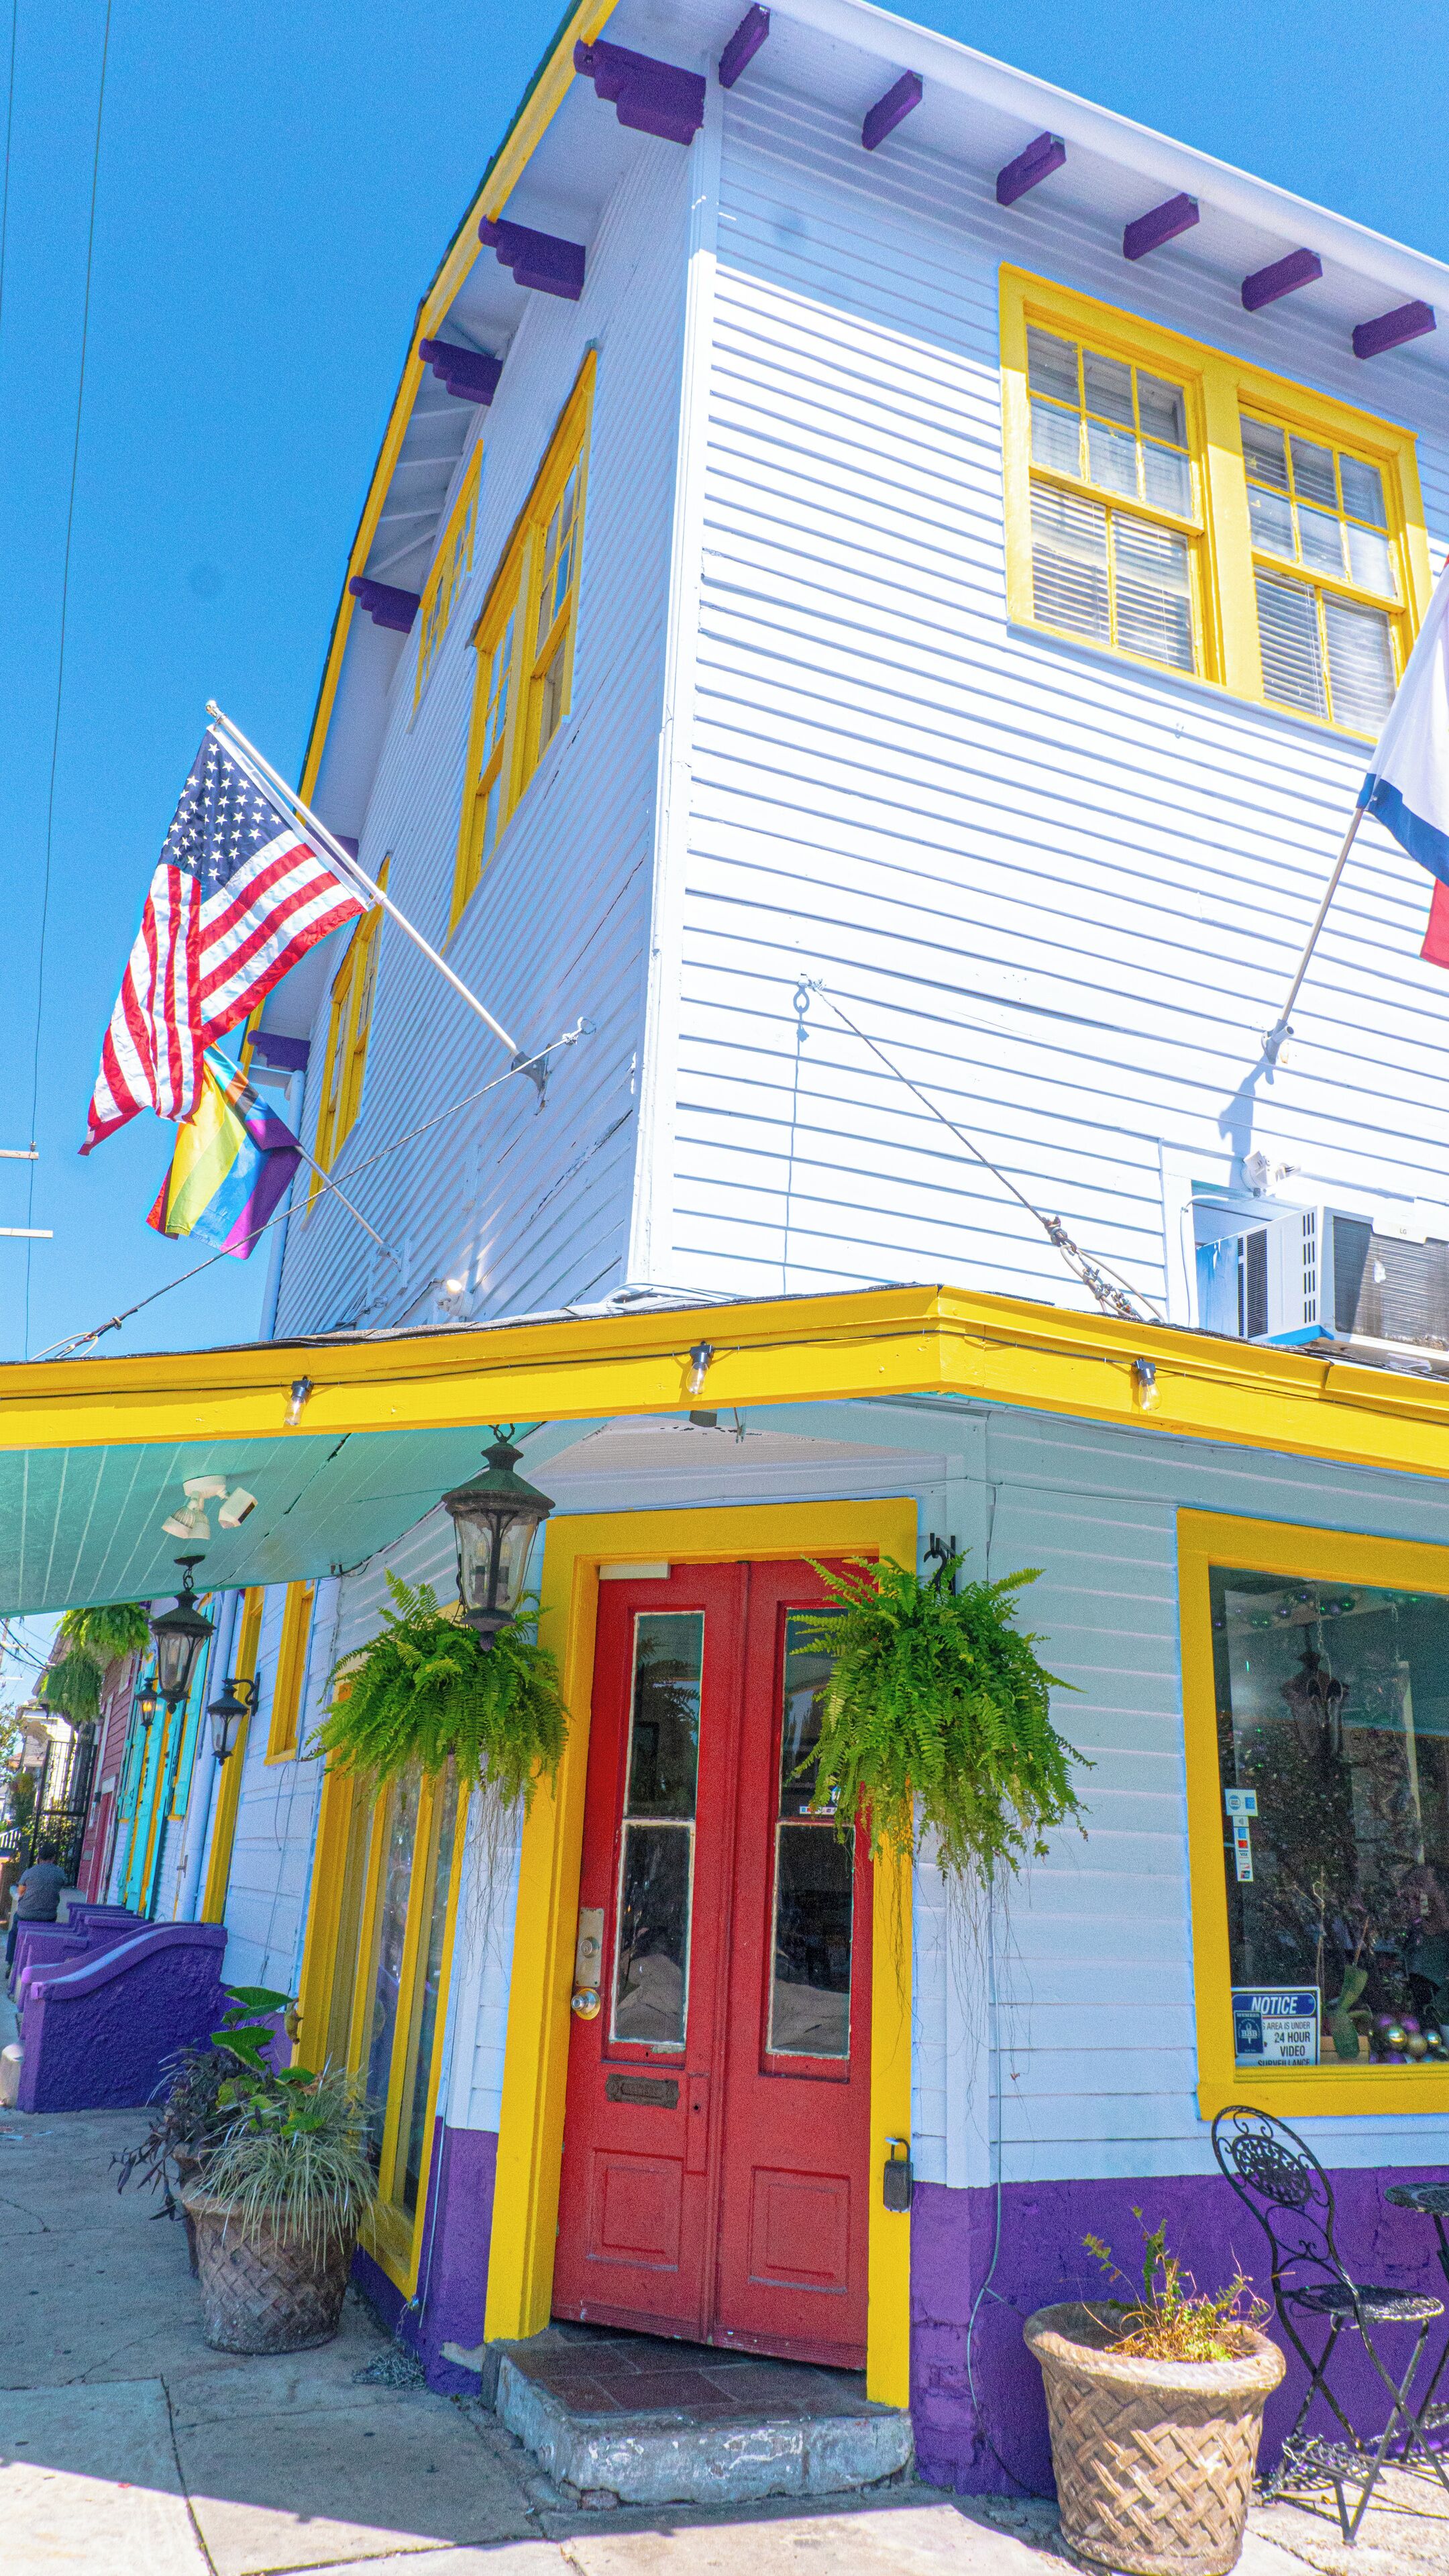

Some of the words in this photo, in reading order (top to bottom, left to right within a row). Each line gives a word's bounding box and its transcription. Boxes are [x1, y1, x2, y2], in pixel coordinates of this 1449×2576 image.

[1251, 1996, 1298, 2015] NOTICE
[1267, 2022, 1283, 2030] AREA
[1284, 2022, 1289, 2030] IS
[1291, 2021, 1310, 2030] UNDER
[1275, 2032, 1285, 2043] 24
[1287, 2031, 1310, 2043] HOUR
[1280, 2045, 1305, 2057] VIDEO
